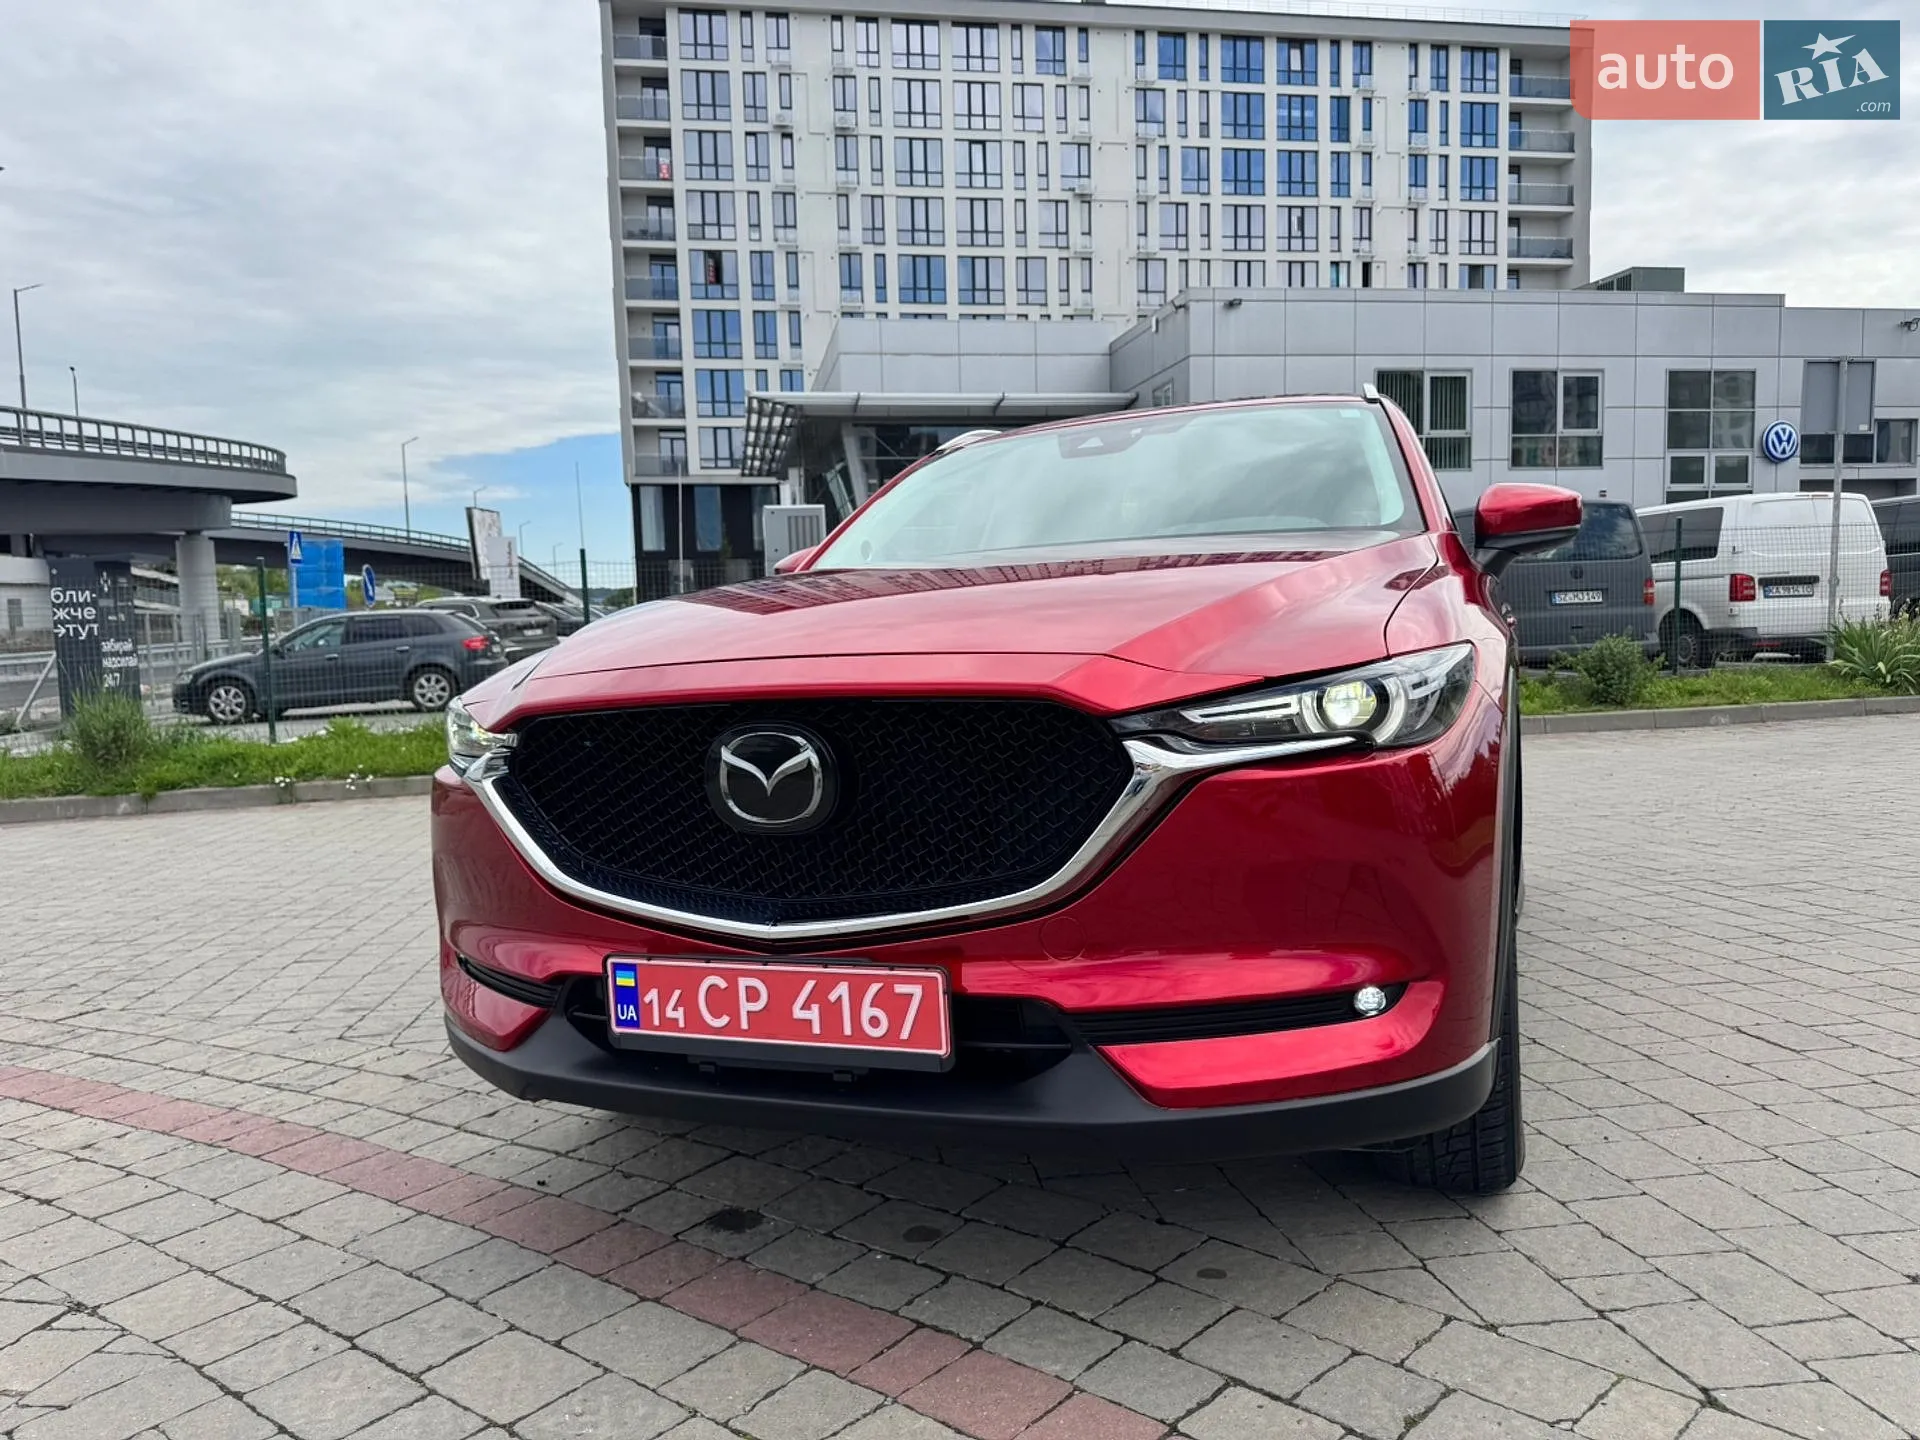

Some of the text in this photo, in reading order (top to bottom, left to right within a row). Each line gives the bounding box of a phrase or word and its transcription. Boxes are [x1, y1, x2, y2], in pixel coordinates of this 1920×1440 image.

[50, 587, 97, 603] бли-
[53, 606, 96, 620] жче
[65, 623, 99, 639] тут
[617, 1003, 638, 1021] UA
[643, 975, 923, 1040] 14 CP 4167
